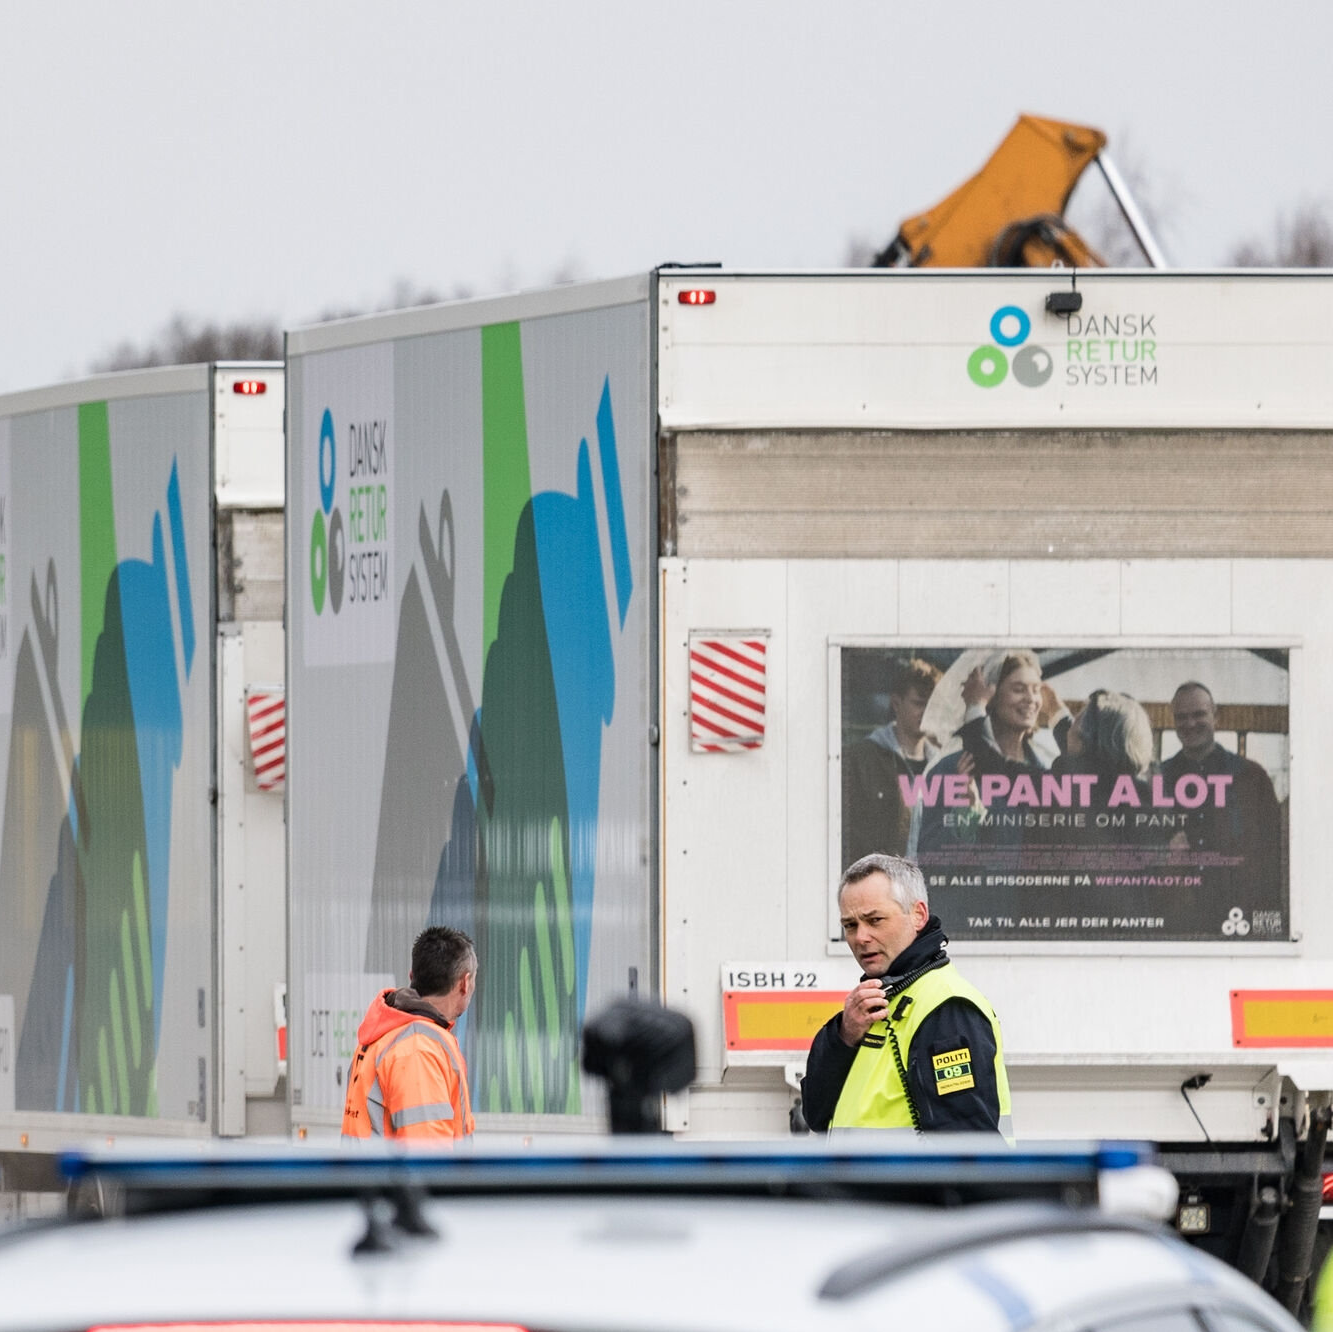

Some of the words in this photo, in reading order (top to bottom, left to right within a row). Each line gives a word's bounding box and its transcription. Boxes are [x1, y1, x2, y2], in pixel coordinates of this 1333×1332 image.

[1067, 313, 1157, 337] DANSK
[1066, 338, 1157, 362] RETUR
[1066, 364, 1158, 386] SYSTEM
[349, 419, 388, 478] DANSK
[349, 484, 388, 544] RETUR
[349, 551, 389, 604] SYSTEM
[898, 774, 971, 808] WE
[981, 774, 1098, 808] PANT
[1107, 774, 1142, 808] A
[1151, 773, 1233, 808] LOT
[943, 813, 971, 827] EN
[978, 813, 1086, 828] MINISERIE
[1095, 812, 1126, 828] OM
[1135, 812, 1189, 828] PANT
[929, 875, 947, 887] SE
[950, 875, 983, 887] ALLE
[986, 875, 1071, 887] EPISODERNE
[1074, 873, 1092, 887] PÅ
[1095, 875, 1203, 887] WEPANTALOT.DK
[967, 916, 992, 928] TAK
[996, 916, 1015, 928] TIL
[1019, 916, 1051, 928] ALLE
[1054, 916, 1079, 928] JER
[1082, 916, 1109, 928] DER
[1113, 916, 1165, 928] PANTER
[729, 972, 786, 988] ISBH
[794, 972, 818, 988] 22
[936, 1052, 968, 1066] POLITI
[944, 1066, 962, 1078] 09
